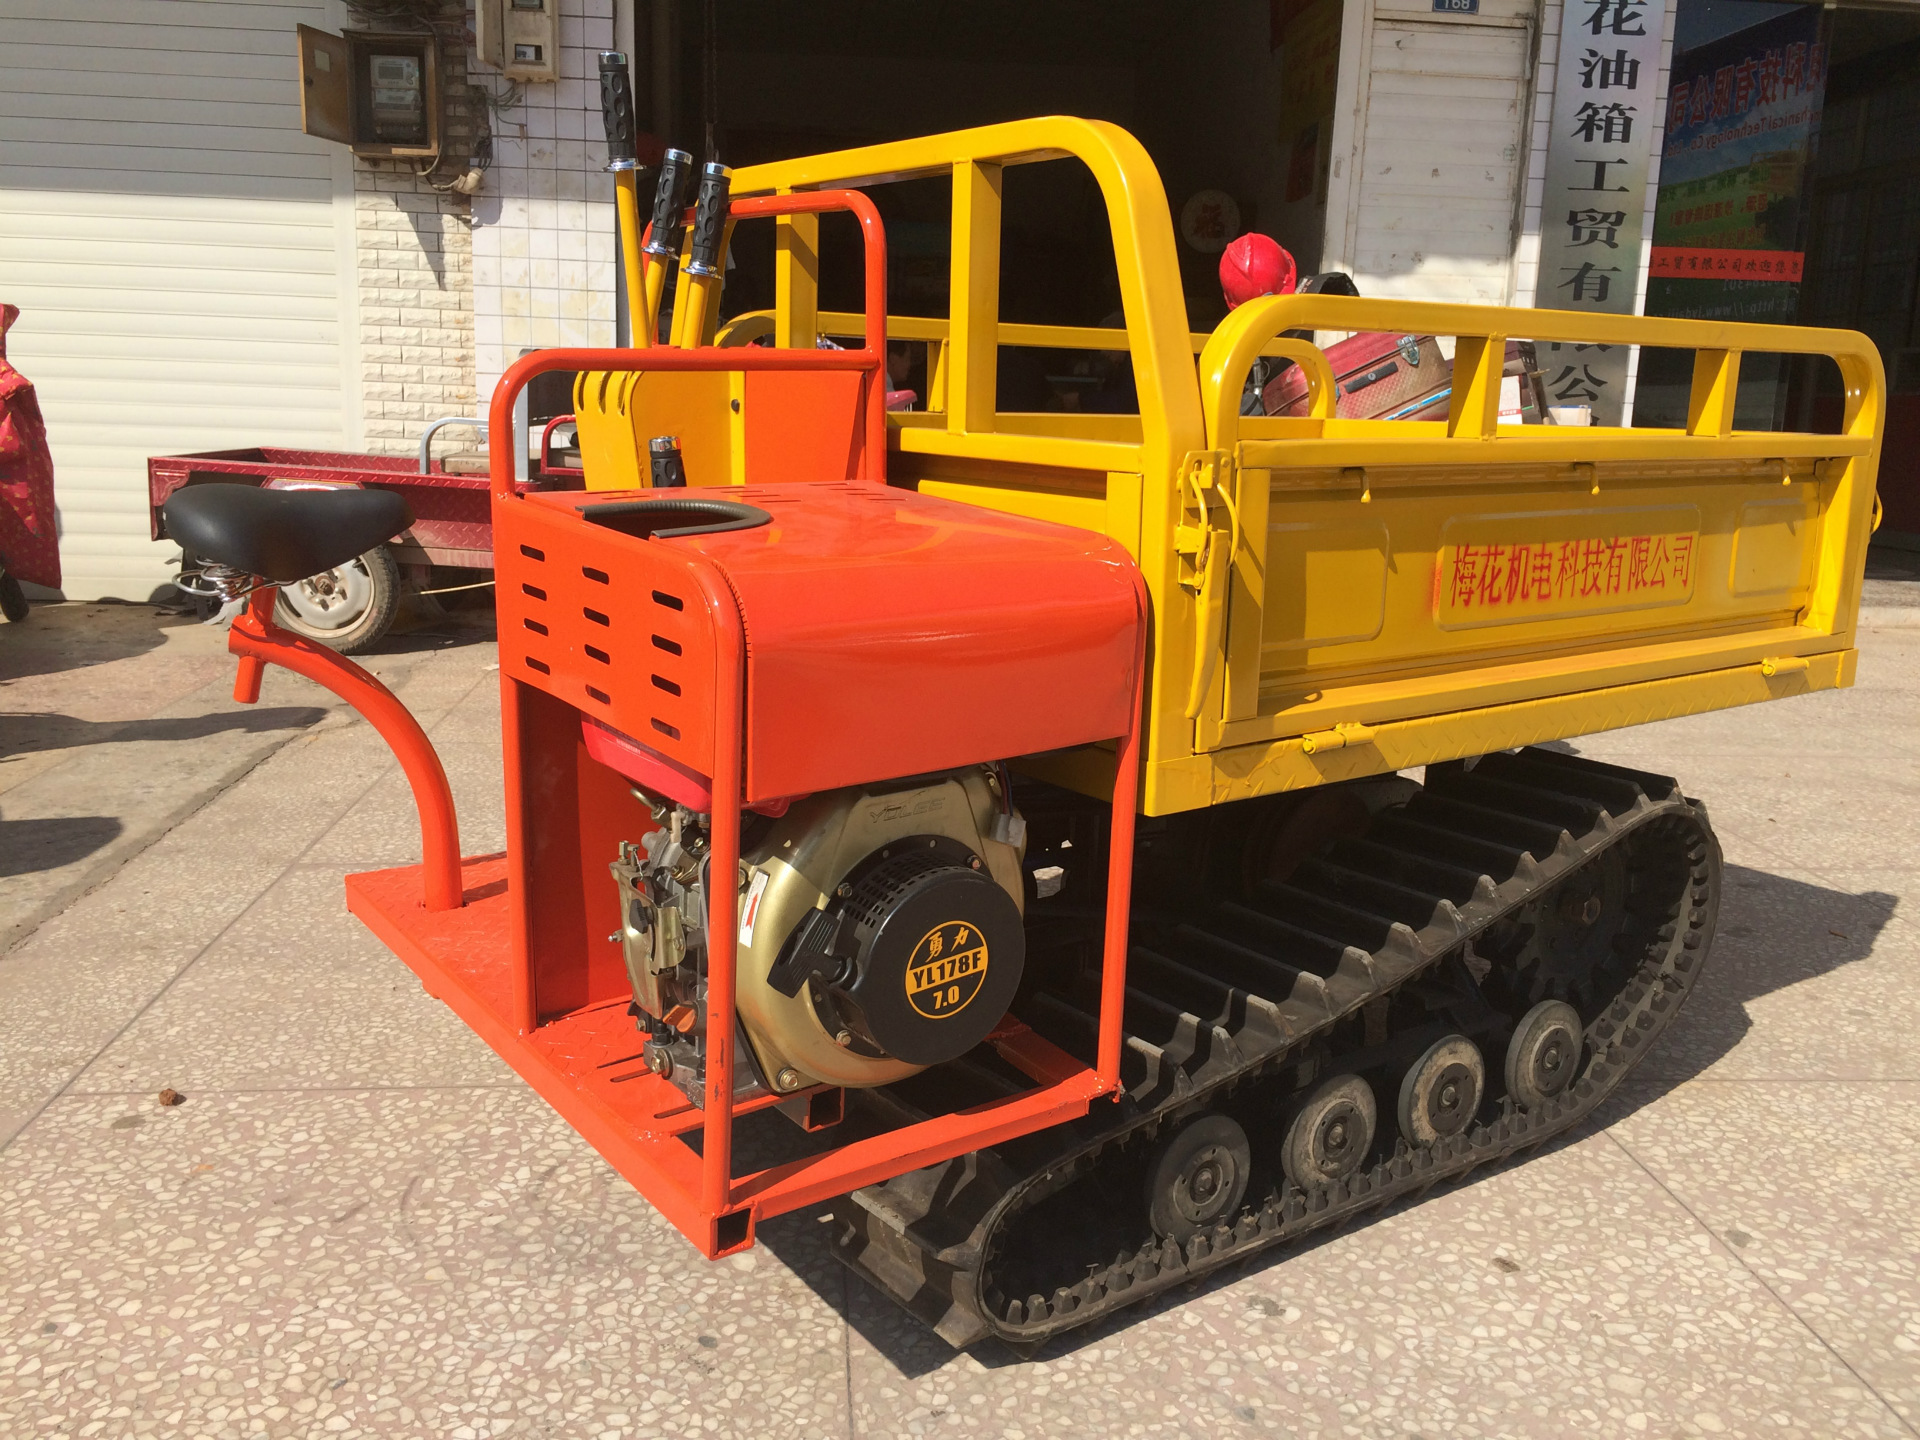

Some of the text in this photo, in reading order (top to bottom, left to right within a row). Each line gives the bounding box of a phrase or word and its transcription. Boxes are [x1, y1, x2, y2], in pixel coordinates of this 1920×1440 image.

[1548, 0, 1649, 426] 花油箱工贸有公
[1450, 535, 1694, 608] 梅花机电科技有限公司
[925, 926, 970, 963] 勇力
[912, 950, 982, 989] YL178F
[932, 985, 960, 1010] 7.0
